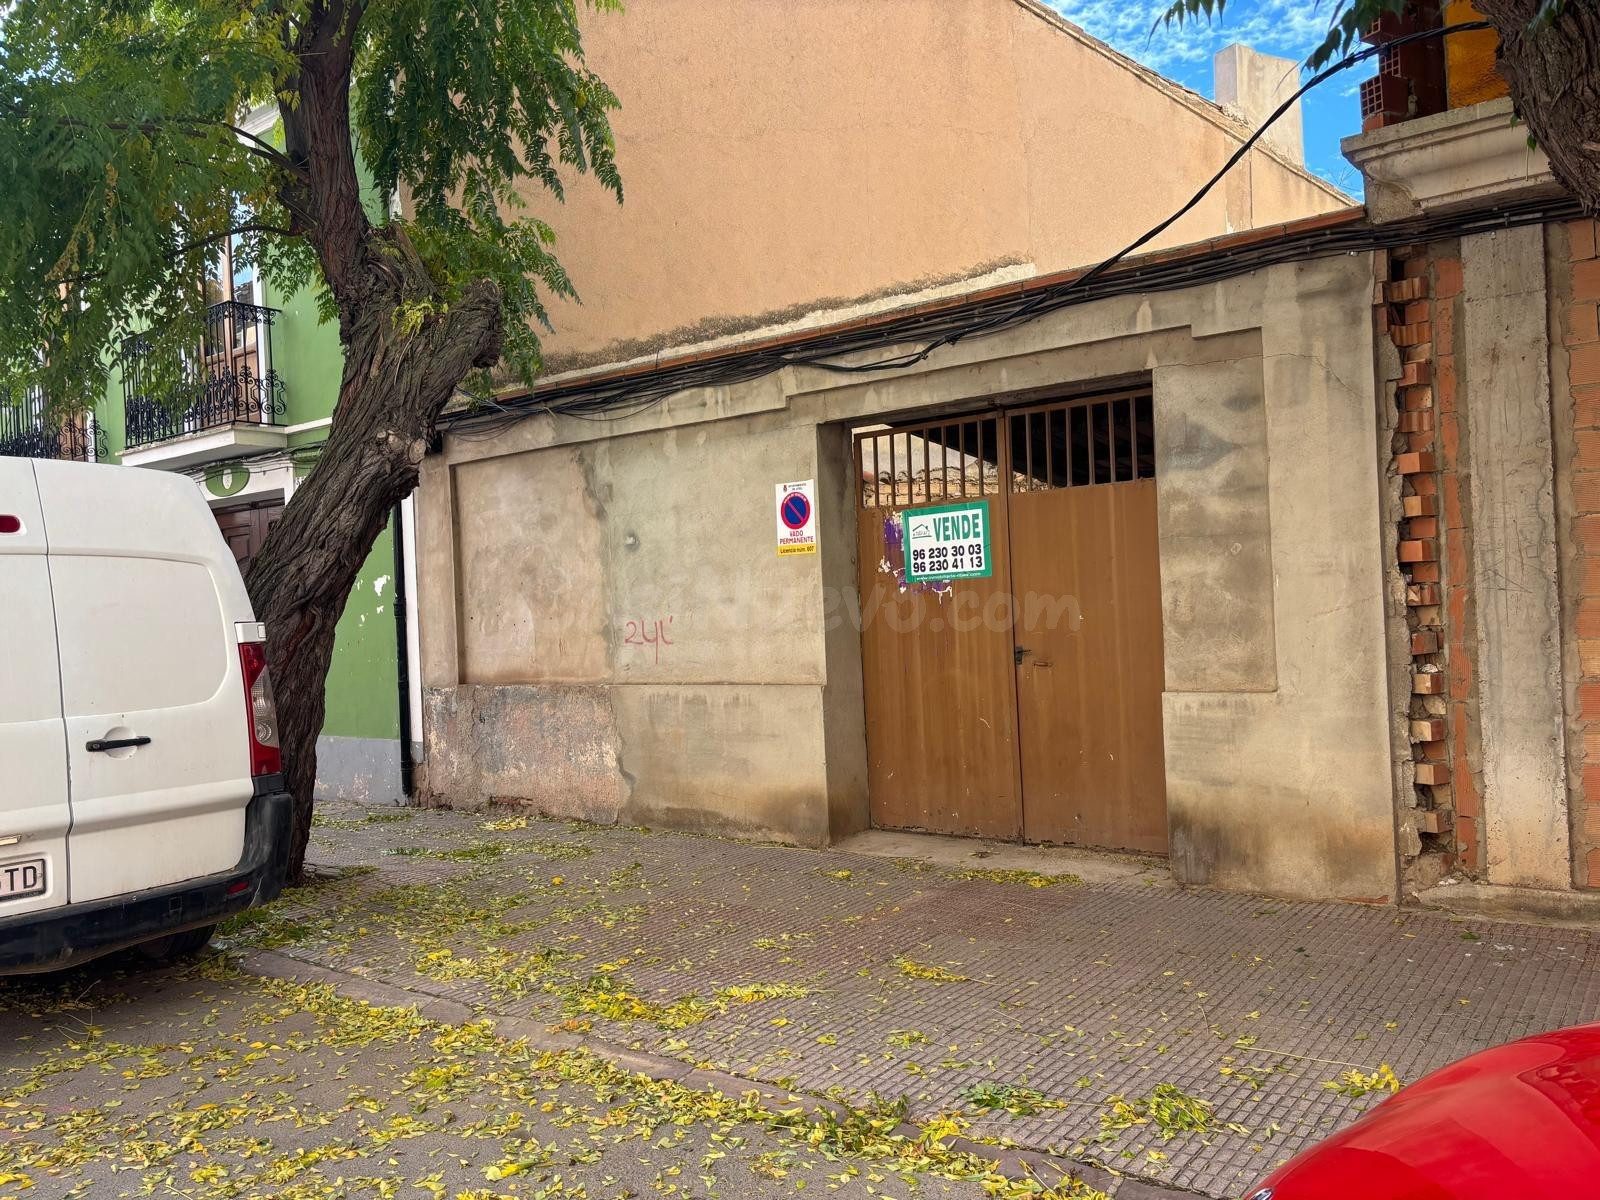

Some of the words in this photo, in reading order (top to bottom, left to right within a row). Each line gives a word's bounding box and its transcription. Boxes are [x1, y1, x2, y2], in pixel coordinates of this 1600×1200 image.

[933, 513, 981, 542] VENDE
[780, 536, 814, 544] PERMANENTE
[912, 549, 925, 561] 96
[928, 546, 948, 559] 230
[951, 545, 965, 557] 30
[968, 543, 982, 555] 03
[913, 561, 926, 573] 96
[929, 559, 949, 572] 230
[952, 557, 964, 570] 41
[969, 556, 983, 568] 13
[0, 866, 37, 892] TD
